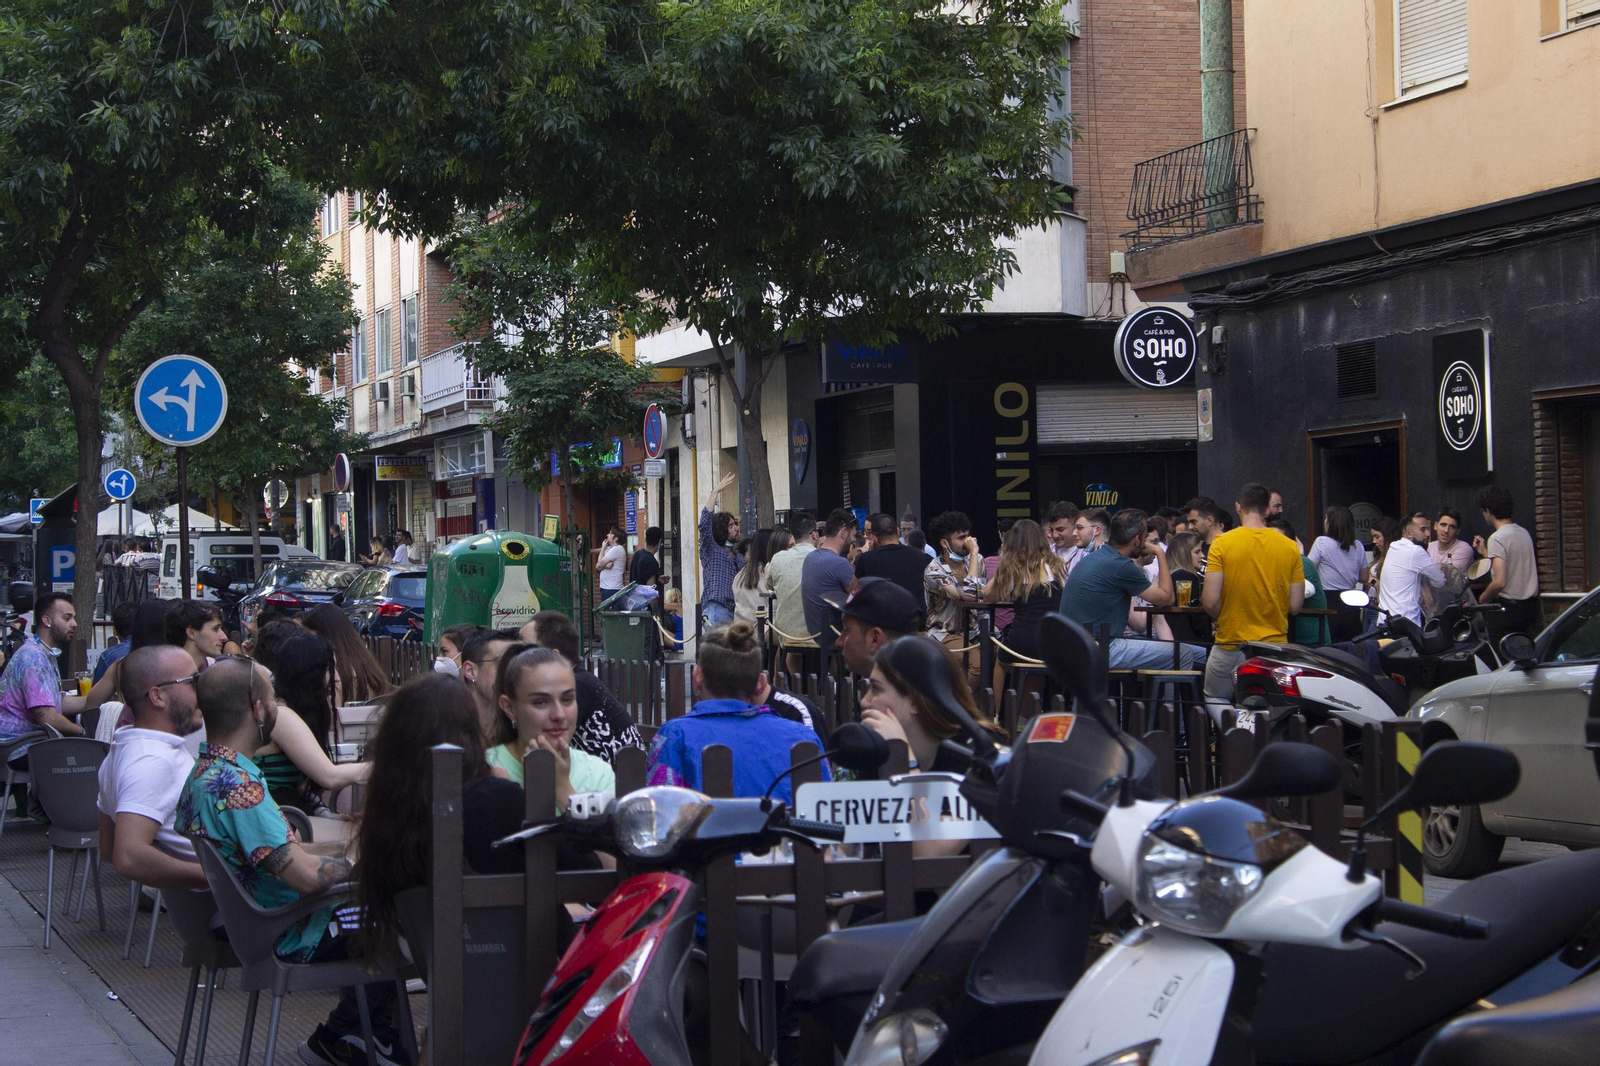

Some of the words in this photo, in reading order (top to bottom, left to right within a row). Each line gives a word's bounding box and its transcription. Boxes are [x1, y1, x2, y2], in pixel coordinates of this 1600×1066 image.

[1143, 328, 1158, 336] CAFÉ
[1133, 338, 1187, 360] SOHO
[1446, 394, 1475, 418] SOHO
[1085, 490, 1119, 506] VINILO
[53, 550, 76, 578] P
[496, 605, 537, 615] ecovidrio
[816, 797, 930, 826] CERVEZAS
